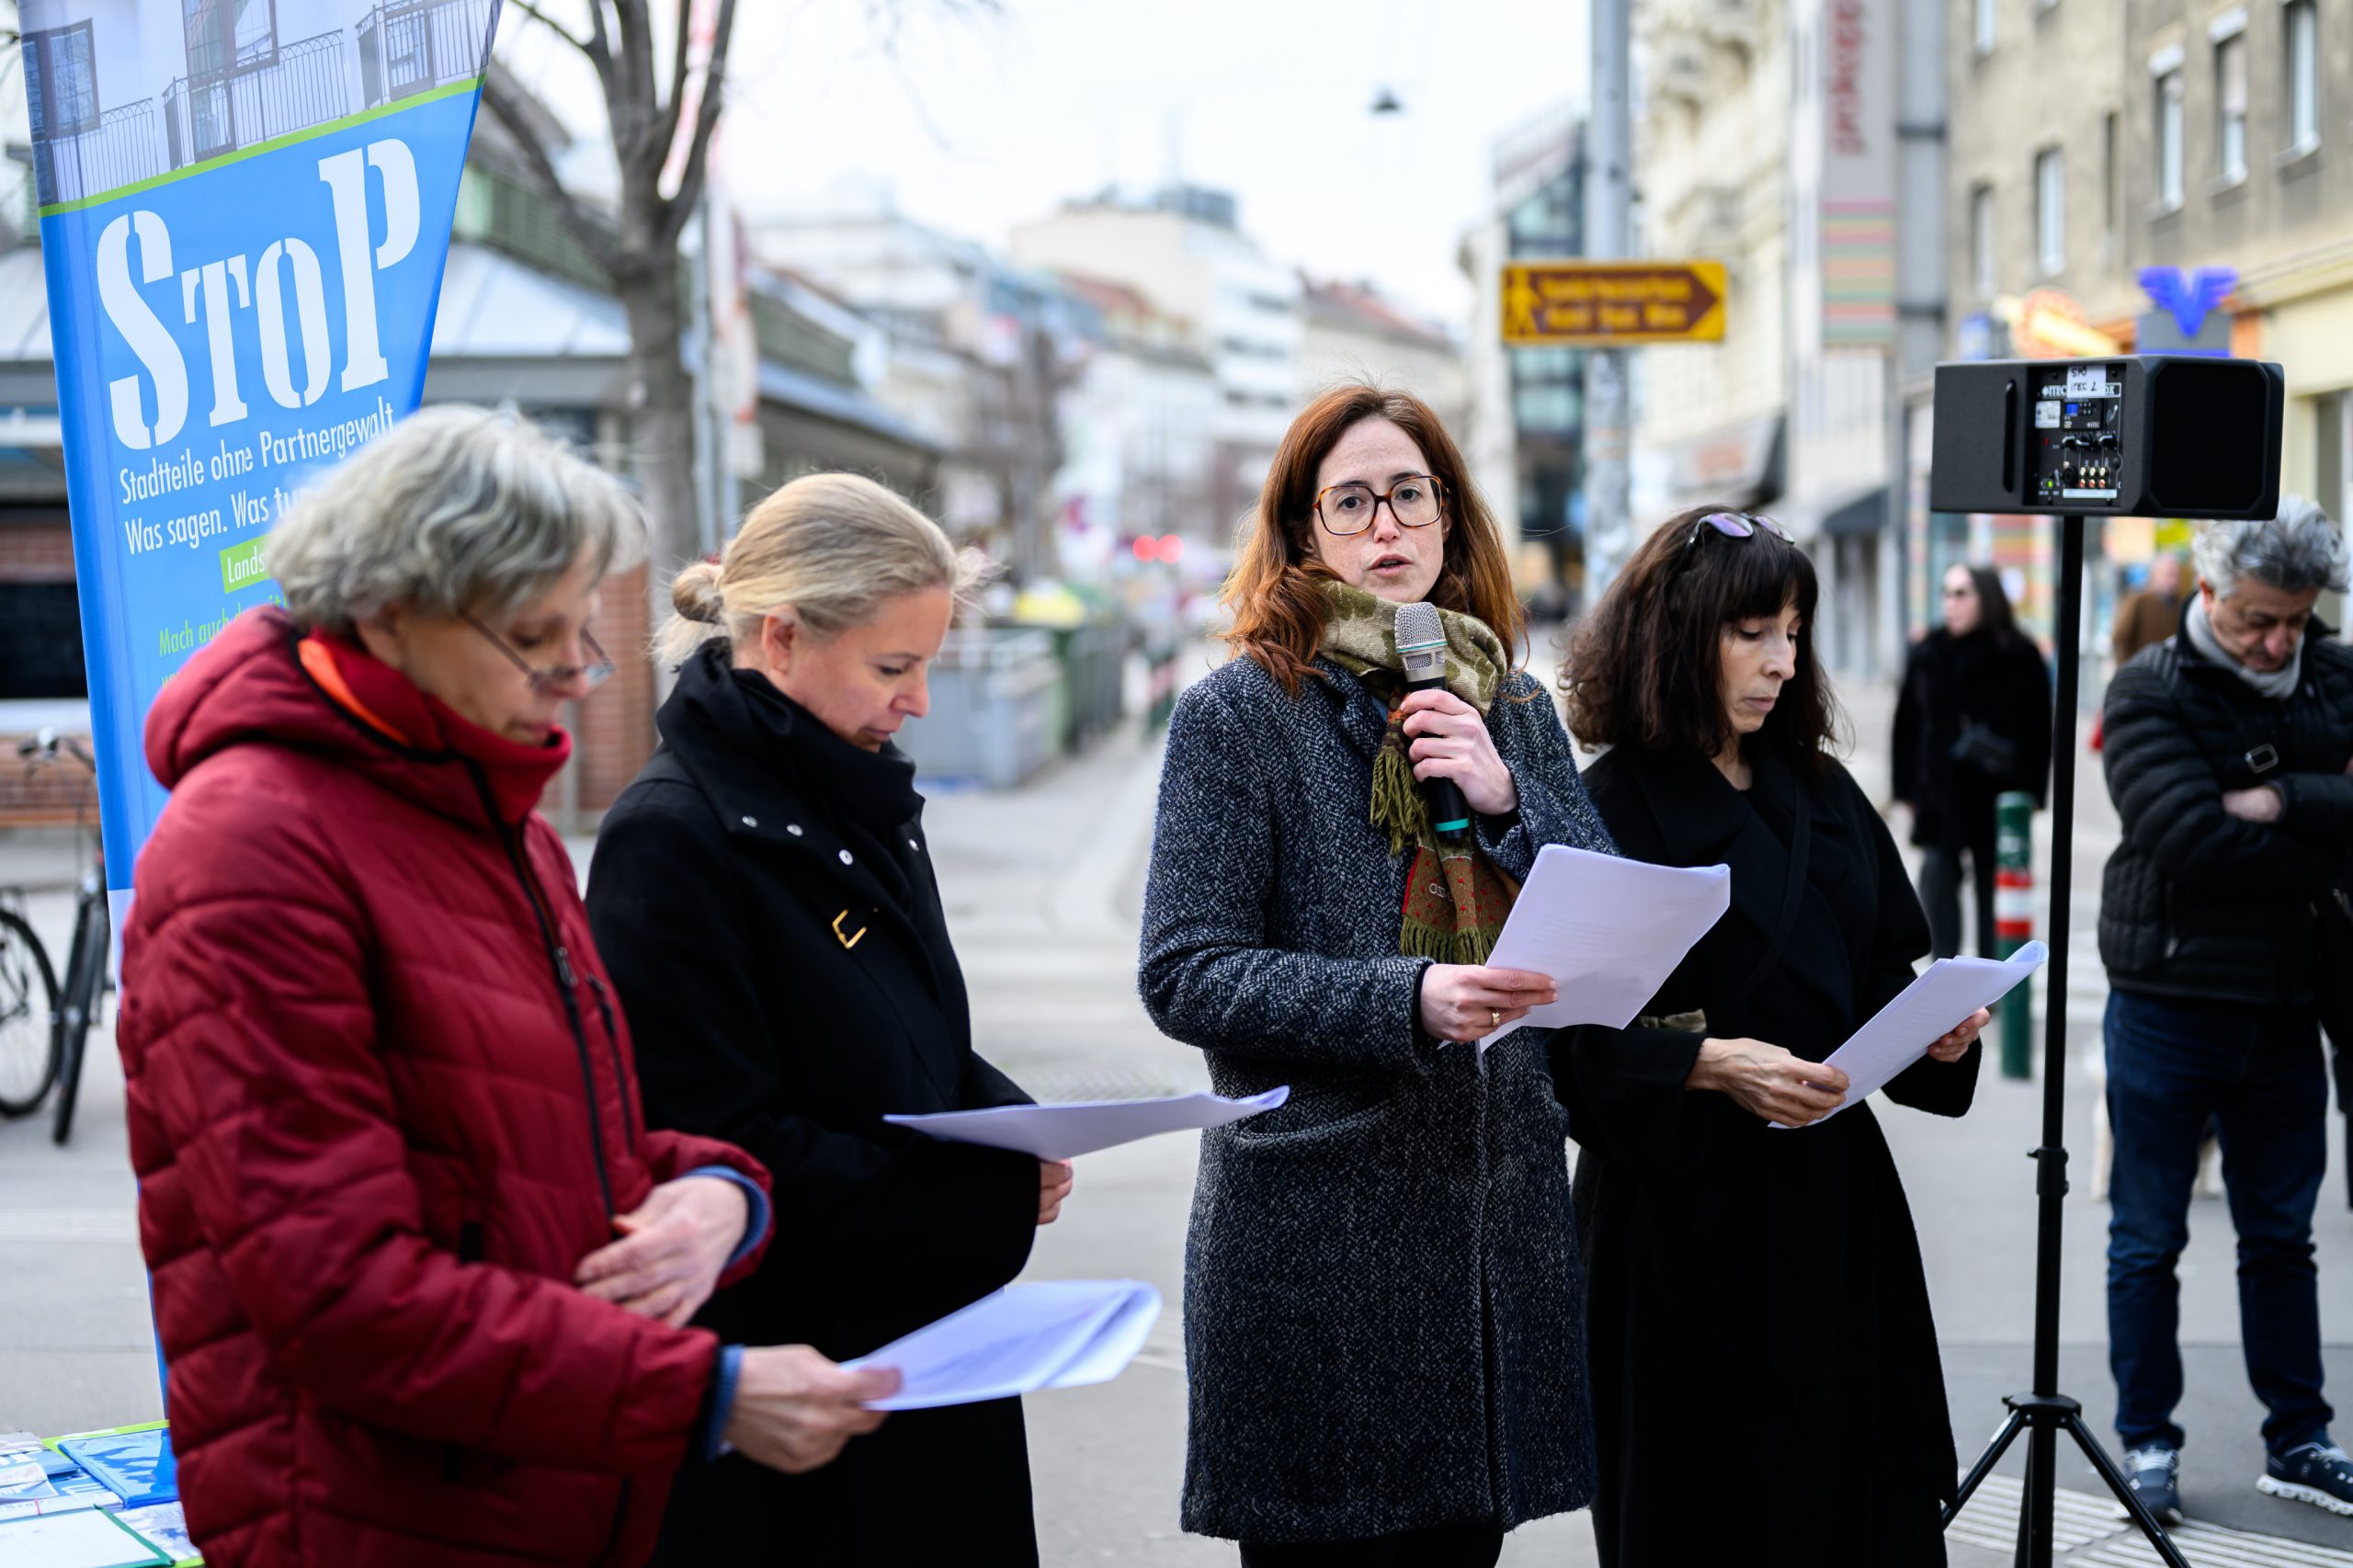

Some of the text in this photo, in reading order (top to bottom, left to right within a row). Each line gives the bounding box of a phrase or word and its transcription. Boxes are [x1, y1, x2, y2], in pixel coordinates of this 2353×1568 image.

[119, 396, 393, 505] Stadtteile ohne Partnergewalt
[125, 517, 163, 555] Was
[166, 507, 228, 550] sagen.
[231, 490, 269, 529] Was
[159, 619, 194, 657] Mach
